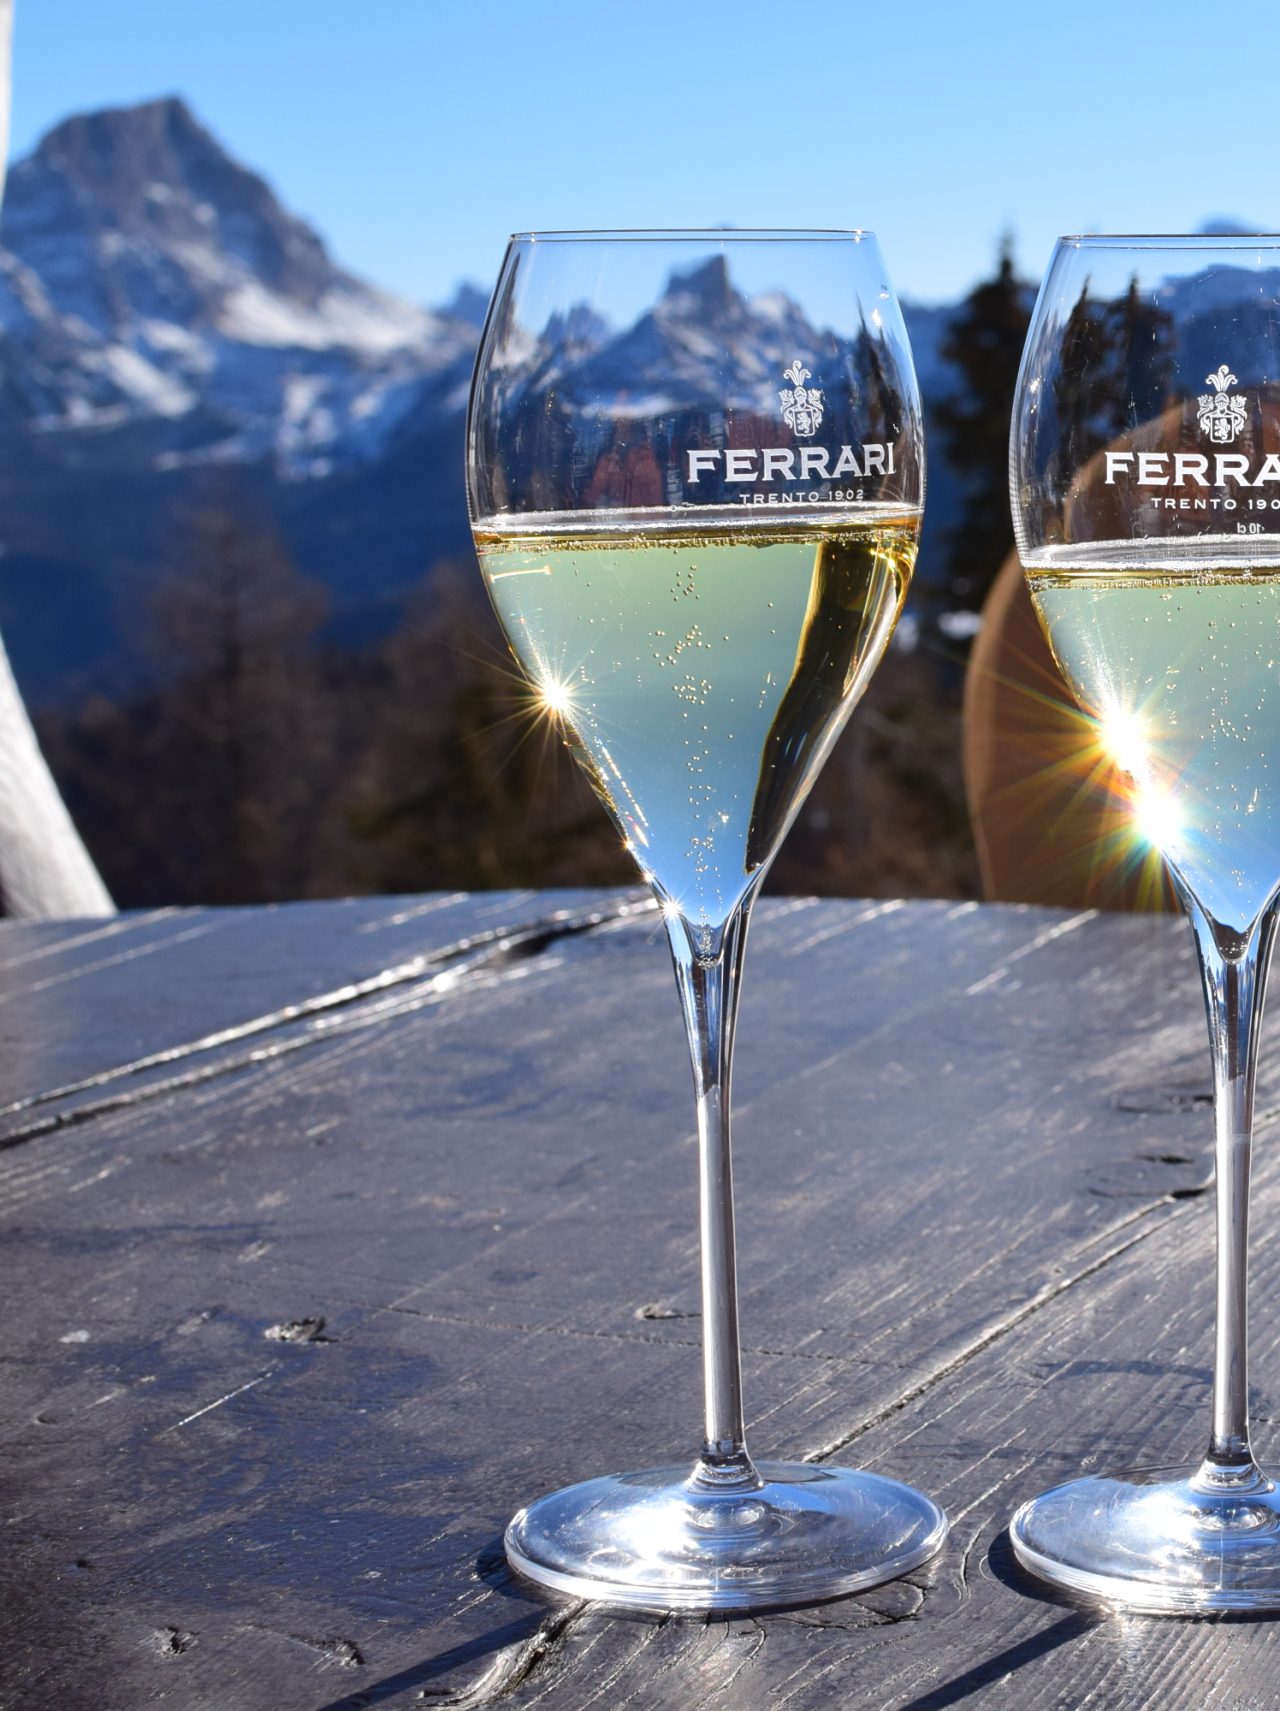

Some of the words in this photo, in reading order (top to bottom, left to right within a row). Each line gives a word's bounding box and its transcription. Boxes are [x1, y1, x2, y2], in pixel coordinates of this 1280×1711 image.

[686, 442, 897, 483] FERRARI
[739, 491, 820, 505] TRENTO
[828, 488, 864, 501] 1902
[1151, 498, 1237, 510] TRENTO
